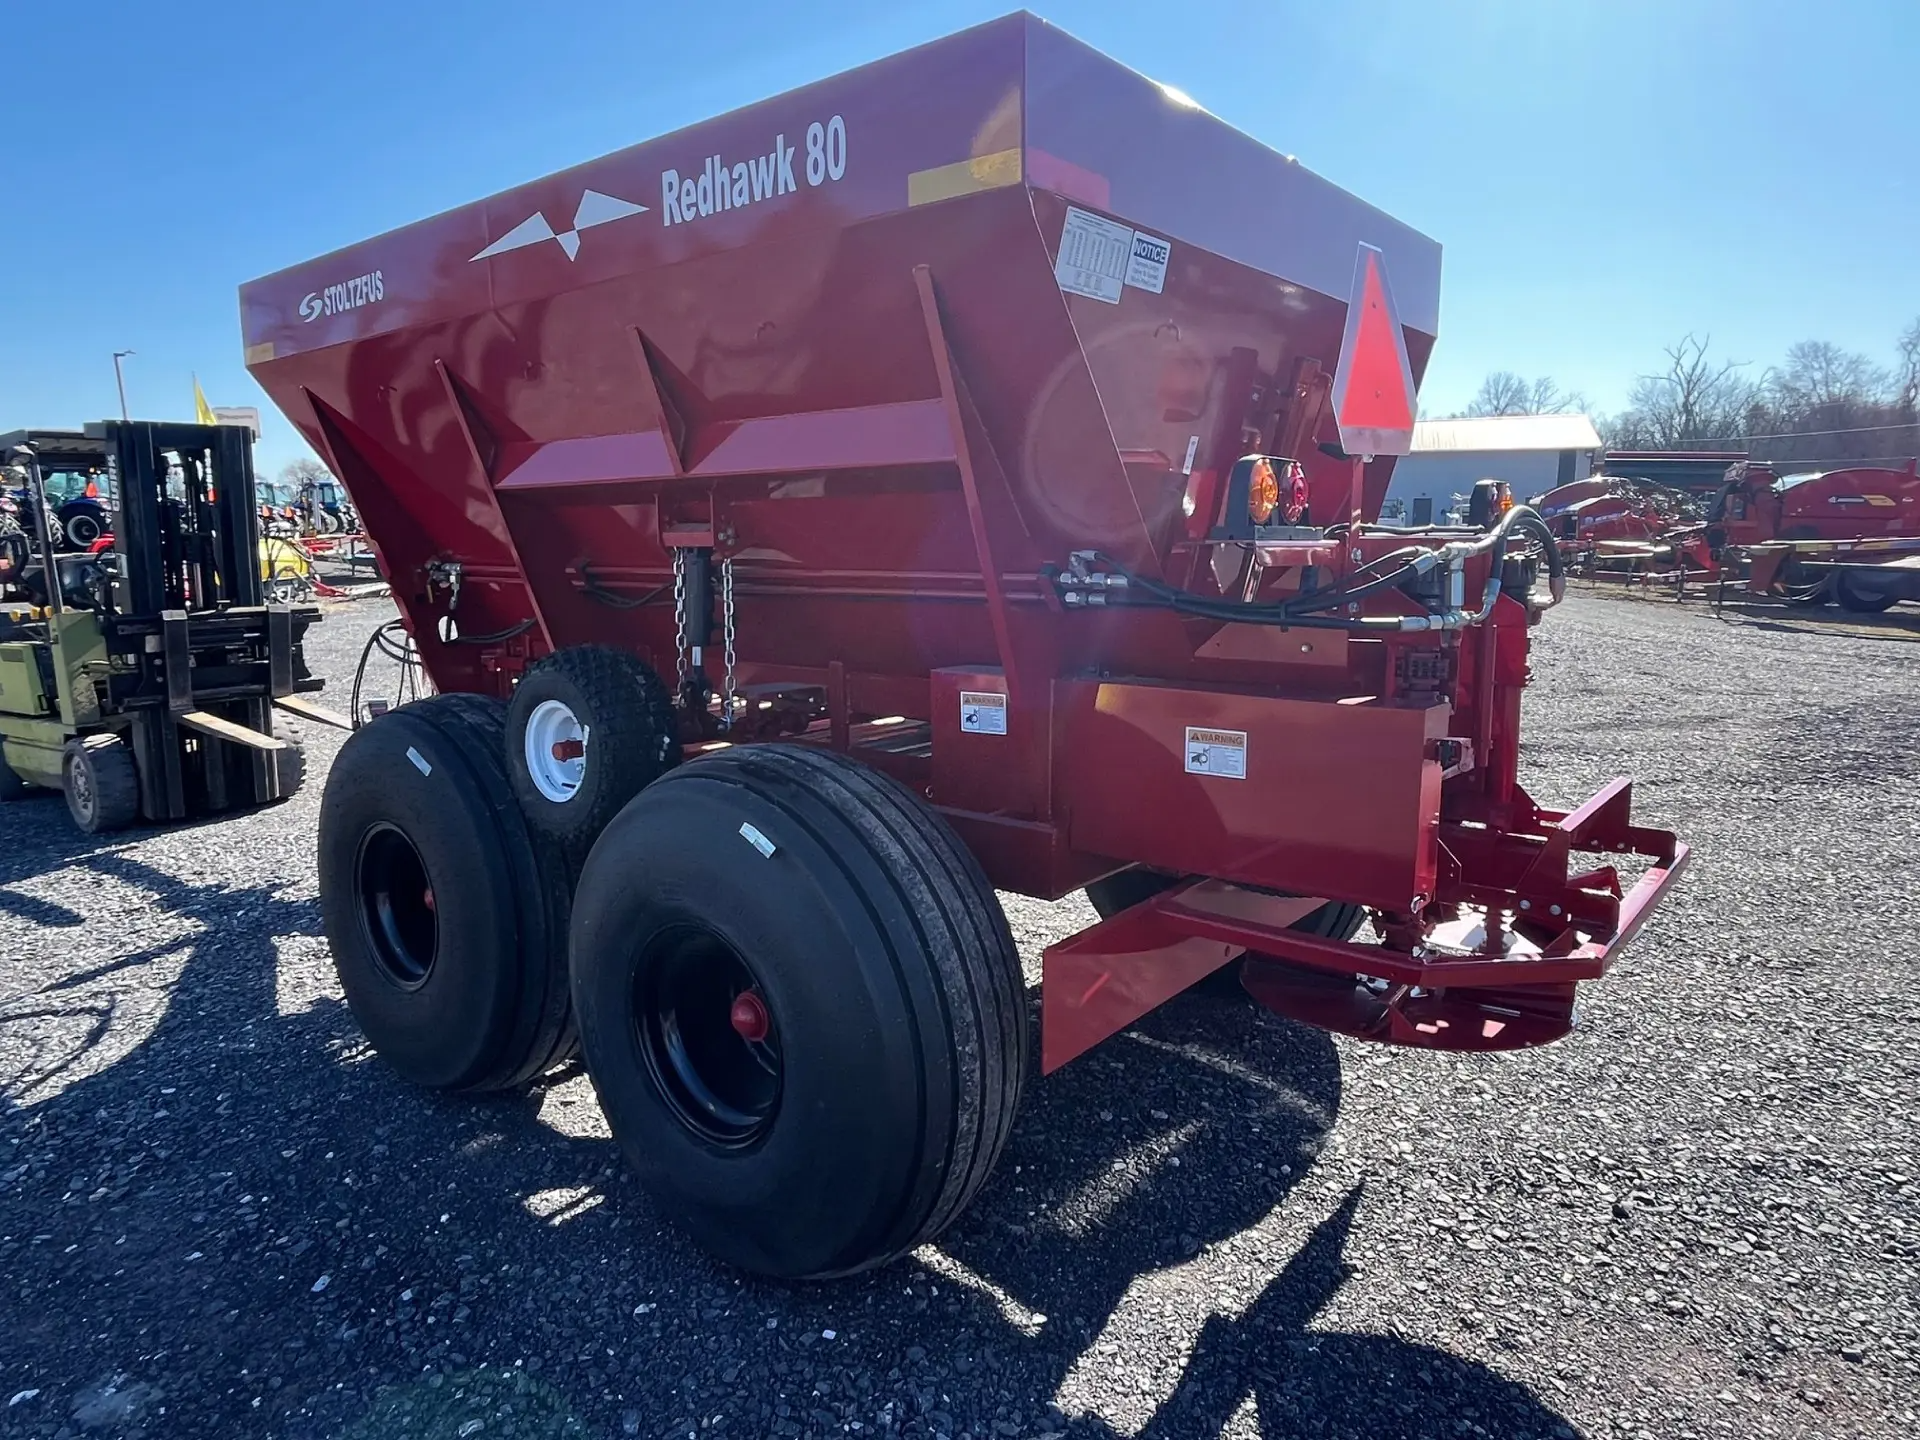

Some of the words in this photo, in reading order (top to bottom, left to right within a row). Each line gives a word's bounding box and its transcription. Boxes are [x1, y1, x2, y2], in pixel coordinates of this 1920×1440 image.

[661, 133, 797, 227] Redhawk
[806, 115, 847, 187] 80
[1133, 240, 1167, 262] NOTICE
[323, 270, 384, 316] STOLTZFUS
[107, 454, 120, 512] CLARK
[1200, 733, 1243, 745] WARNING
